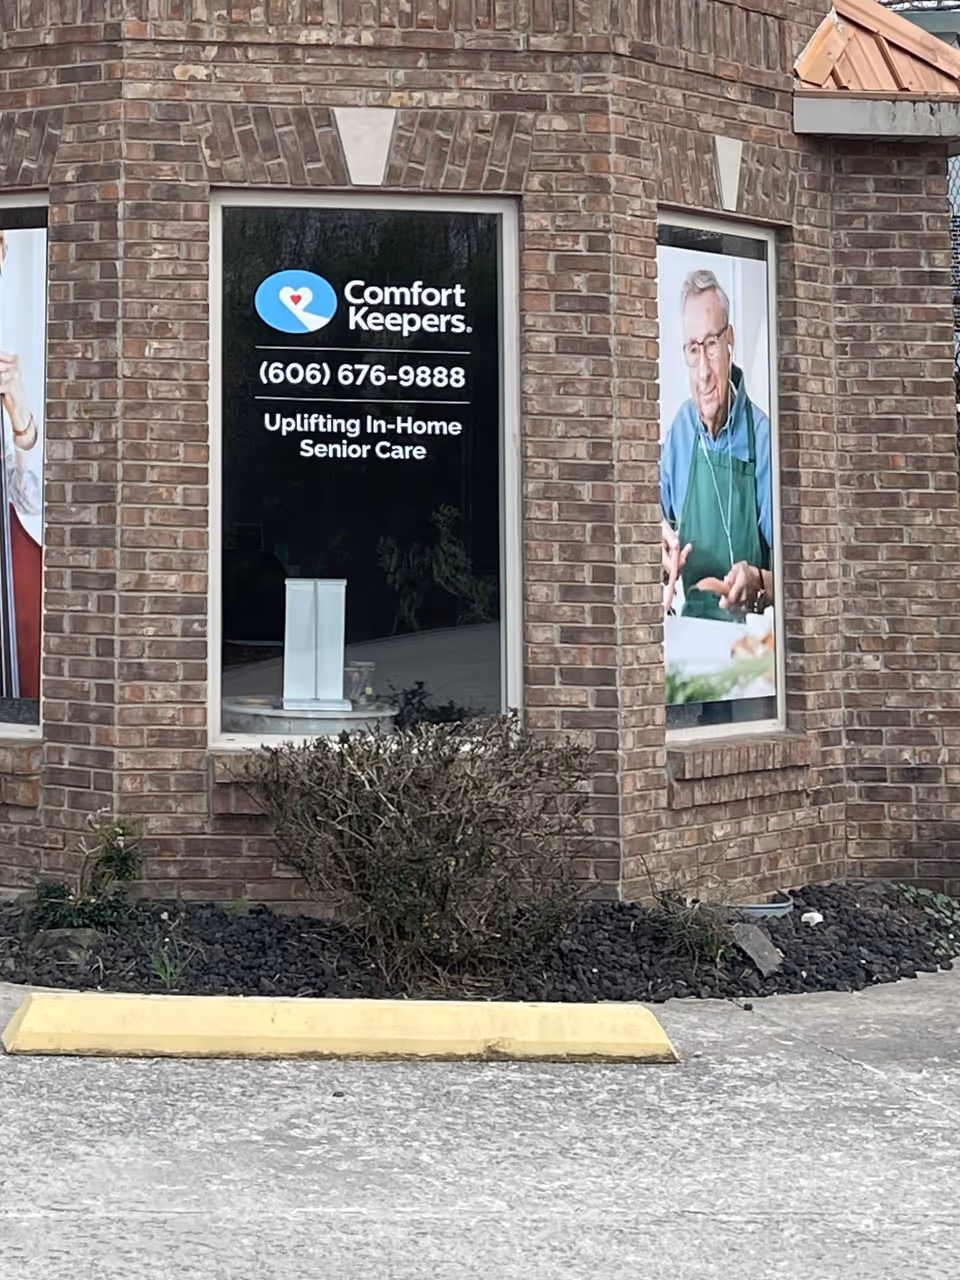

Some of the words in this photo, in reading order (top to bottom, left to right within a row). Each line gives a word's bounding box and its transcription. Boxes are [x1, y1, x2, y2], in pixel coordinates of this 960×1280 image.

[344, 280, 466, 308] Comfort
[259, 361, 331, 386] (606)
[337, 364, 466, 388] 676-9888
[264, 413, 361, 437] Uplifting
[366, 416, 463, 436] In-Home
[300, 439, 371, 459] Senior
[375, 441, 428, 460] Care
